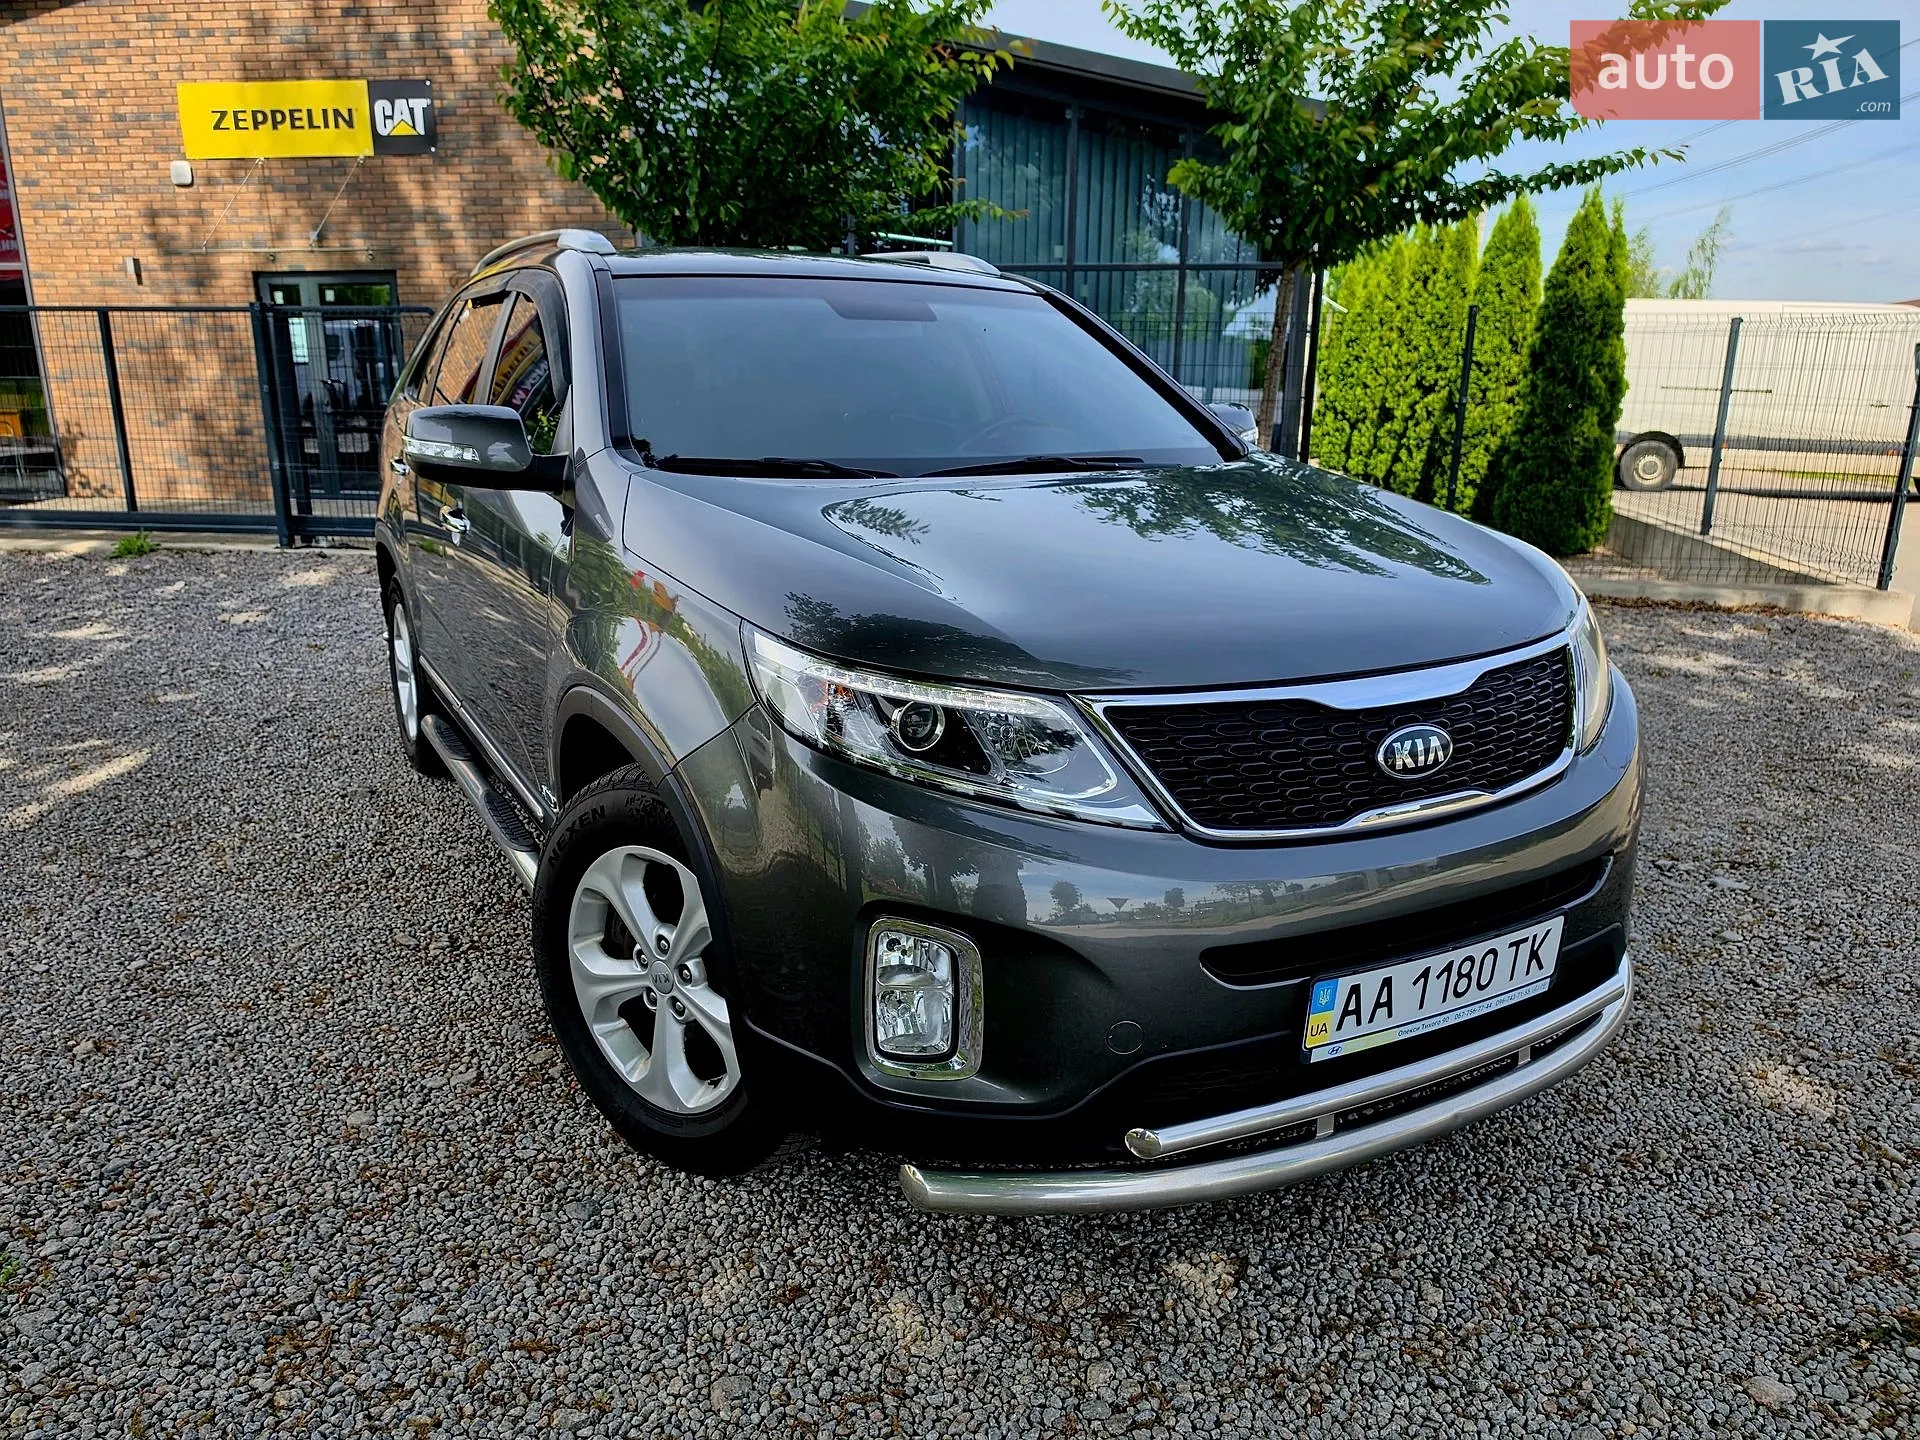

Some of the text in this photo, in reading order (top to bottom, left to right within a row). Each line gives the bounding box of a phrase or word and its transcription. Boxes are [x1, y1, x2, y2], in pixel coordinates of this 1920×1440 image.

[211, 108, 356, 131] ZEPPELIN
[373, 97, 429, 137] CAT
[1392, 735, 1445, 770] KIA
[547, 805, 606, 867] NEXEN
[1336, 927, 1552, 1031] AA 1180 TK
[1310, 1022, 1328, 1037] UA
